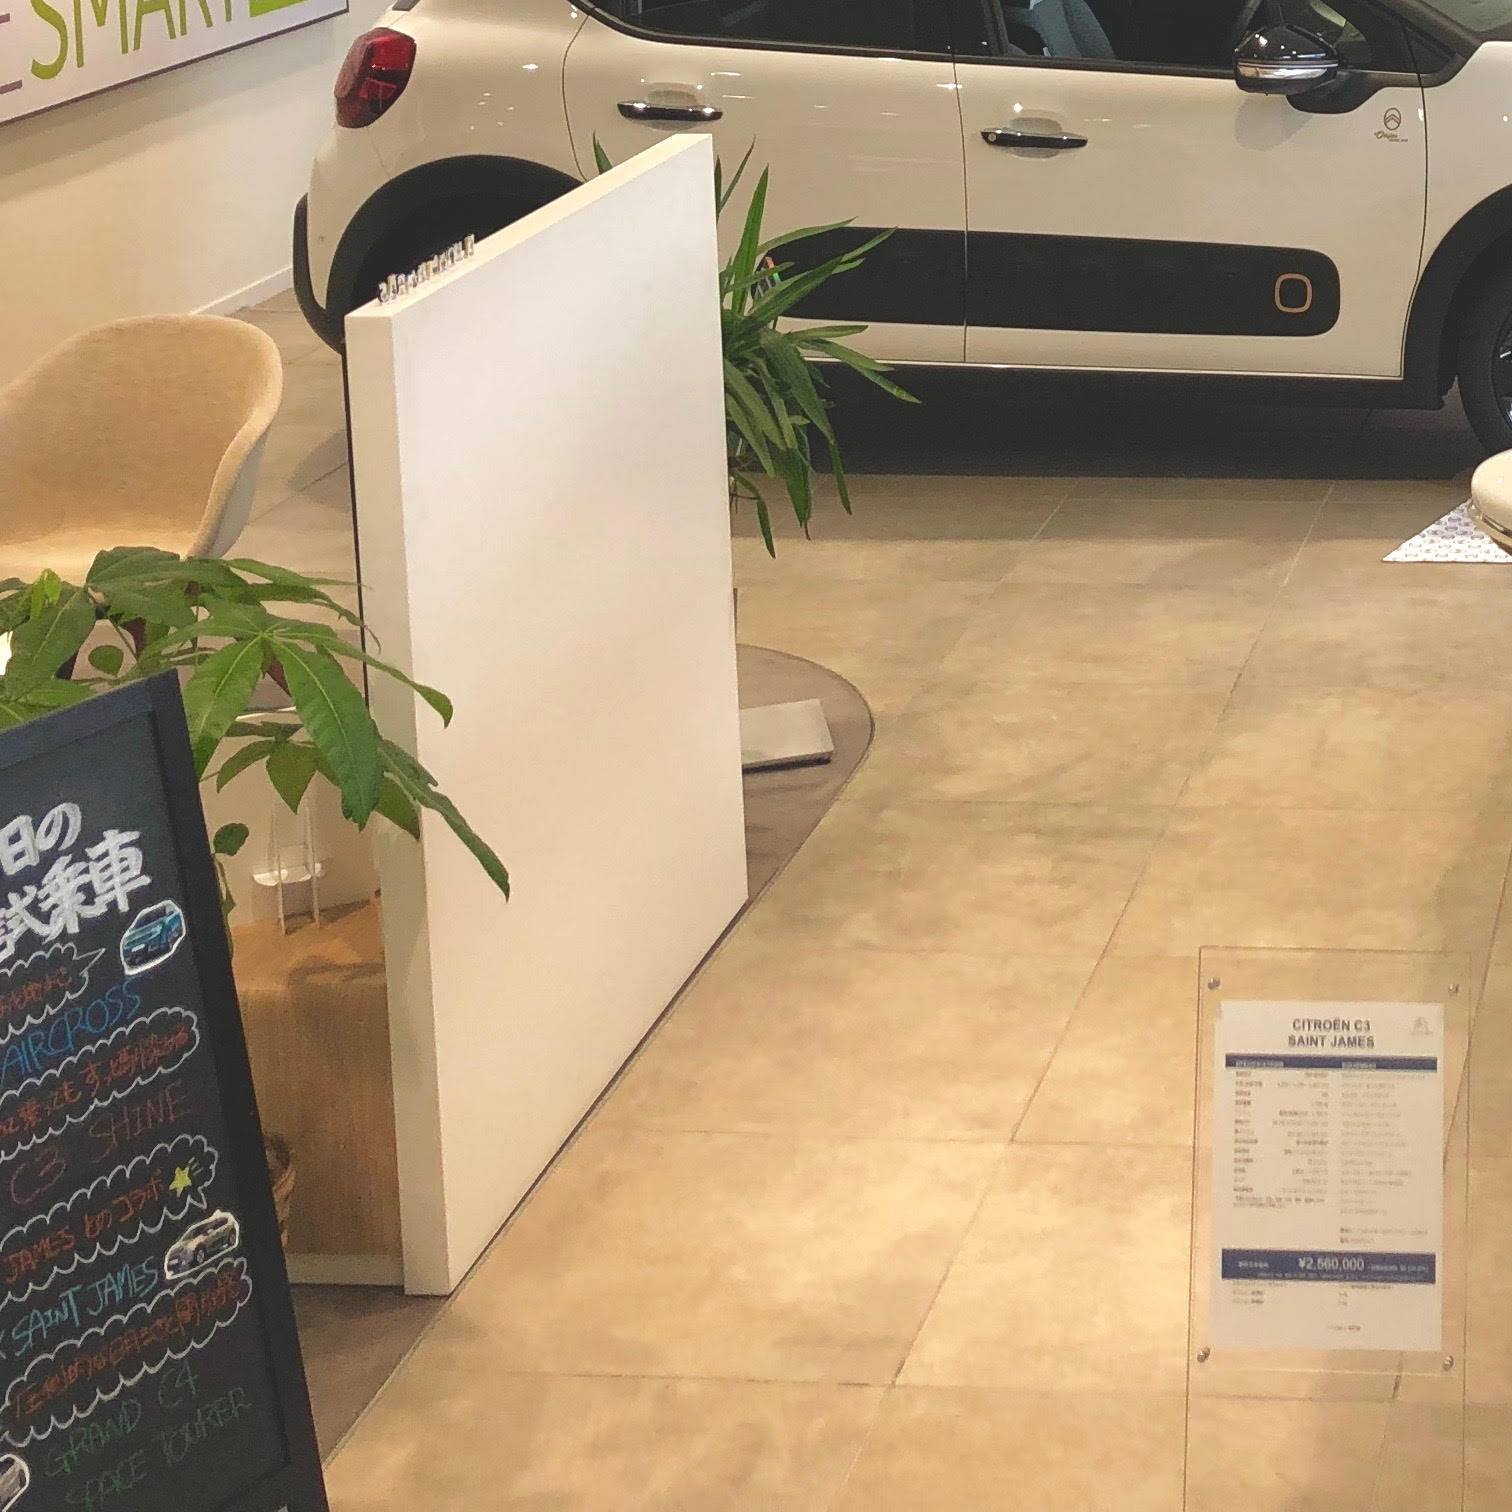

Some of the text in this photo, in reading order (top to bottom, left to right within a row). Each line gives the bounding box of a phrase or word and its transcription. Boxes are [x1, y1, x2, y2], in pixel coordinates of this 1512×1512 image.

[1288, 1035, 1375, 1049] SAINT JAMES
[1292, 1017, 1351, 1032] CITROËN
[88, 1078, 190, 1166] SHINE
[11, 1285, 82, 1357] SAINT
[86, 1256, 159, 1316] JAMES
